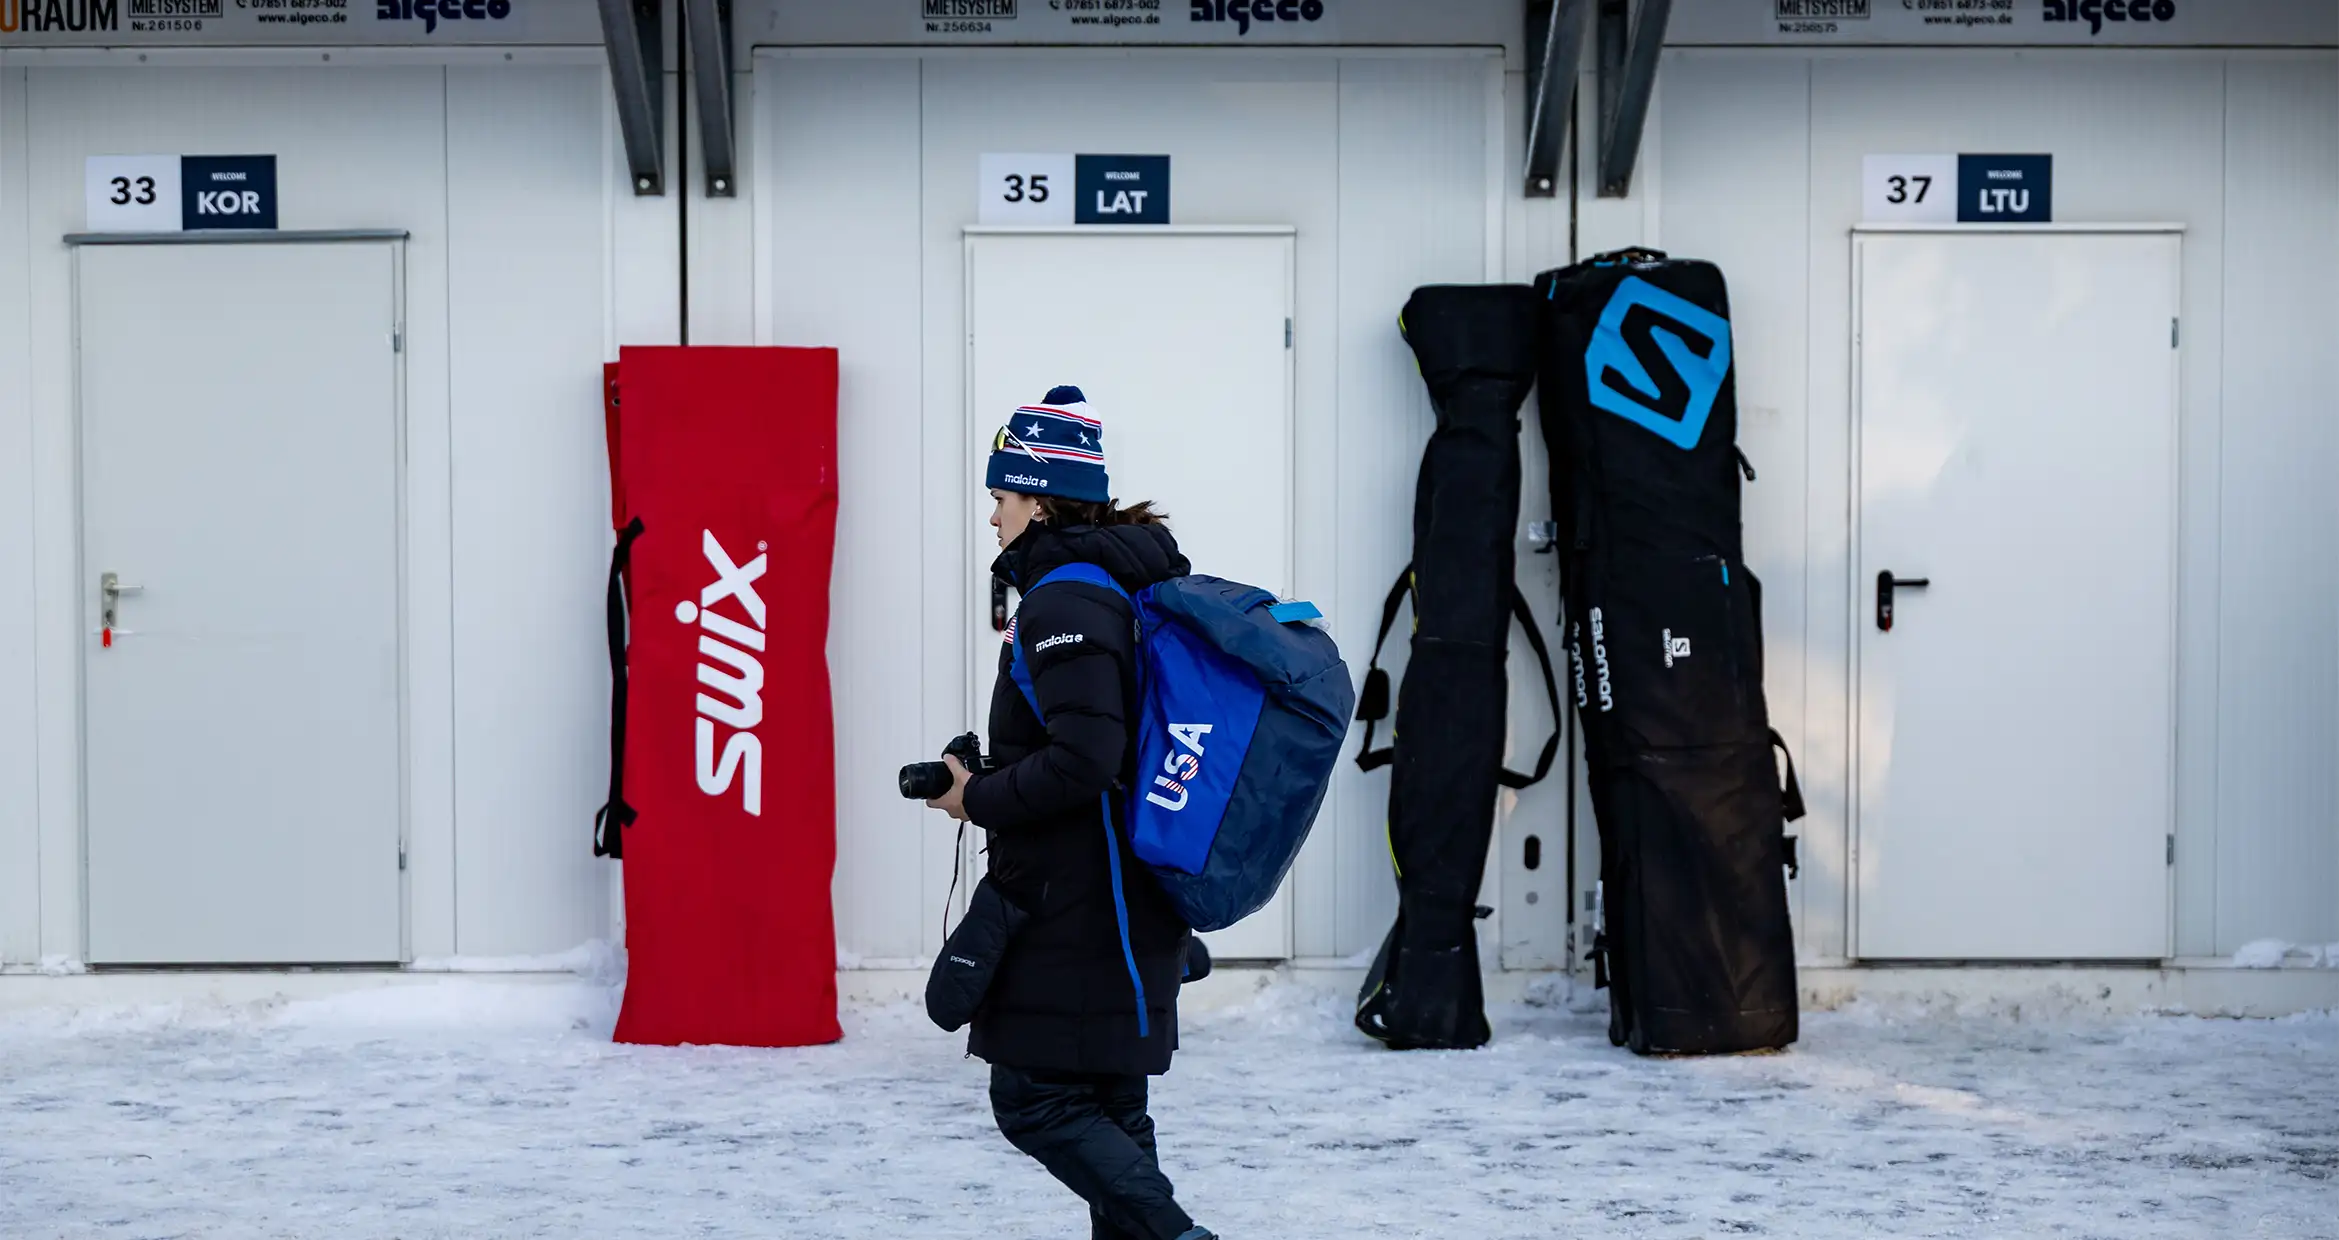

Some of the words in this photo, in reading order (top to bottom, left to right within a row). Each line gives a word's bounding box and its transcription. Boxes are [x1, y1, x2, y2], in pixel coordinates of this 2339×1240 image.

[132, 0, 219, 14] MIETSYSTEM
[377, 0, 511, 34] algeco
[926, 0, 1013, 15] MIETSYSTEM
[1779, 0, 1867, 15] MIETSYSTEM
[258, 12, 347, 24] www.algeco.de
[1071, 14, 1160, 26] www.algeco.de
[1190, 0, 1323, 36] algeco
[1924, 14, 2013, 26] www.algeco.de
[2043, 0, 2176, 36] algeco
[211, 172, 247, 181] WELCOME
[1105, 171, 1140, 180] WELCOME
[1987, 170, 2023, 180] WELCOME
[110, 176, 157, 206] 33
[1003, 173, 1050, 203] 35
[1886, 174, 1933, 204] 37
[197, 190, 261, 215] KOR
[1096, 189, 1148, 214] LAT
[1979, 188, 2029, 213] LTU
[1004, 473, 1040, 487] maloja
[1035, 632, 1074, 653] maloja
[1145, 723, 1214, 812] USA
